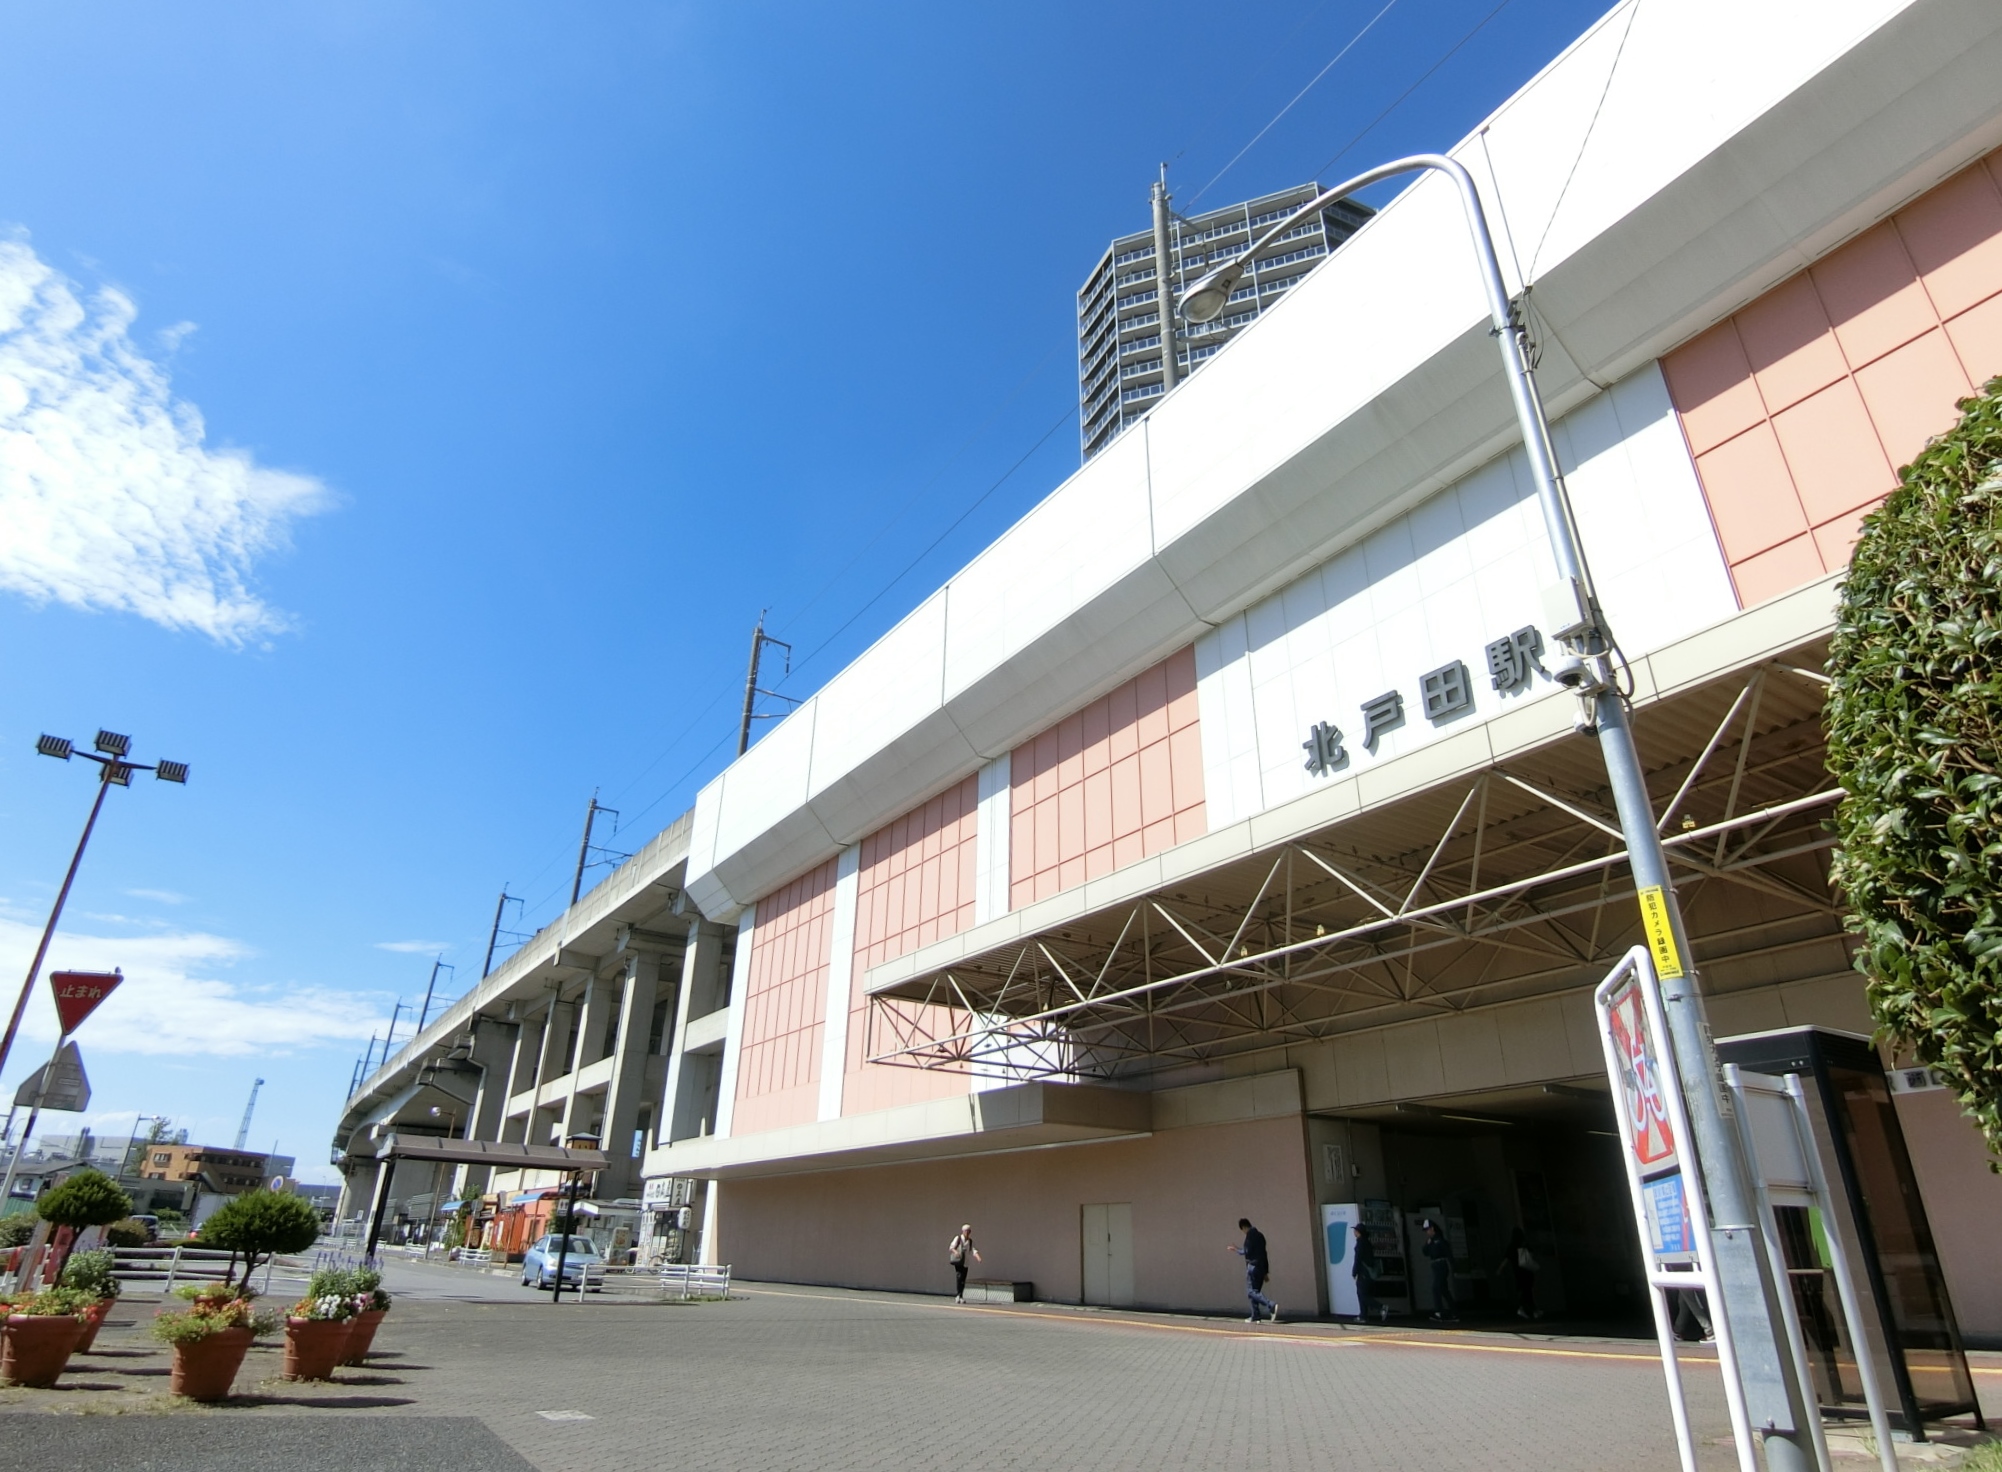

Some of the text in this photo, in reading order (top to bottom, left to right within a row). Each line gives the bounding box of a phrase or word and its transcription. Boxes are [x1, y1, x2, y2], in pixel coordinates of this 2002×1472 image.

[1302, 624, 1546, 771] 北戸田駅
[59, 984, 102, 999] 止まれ
